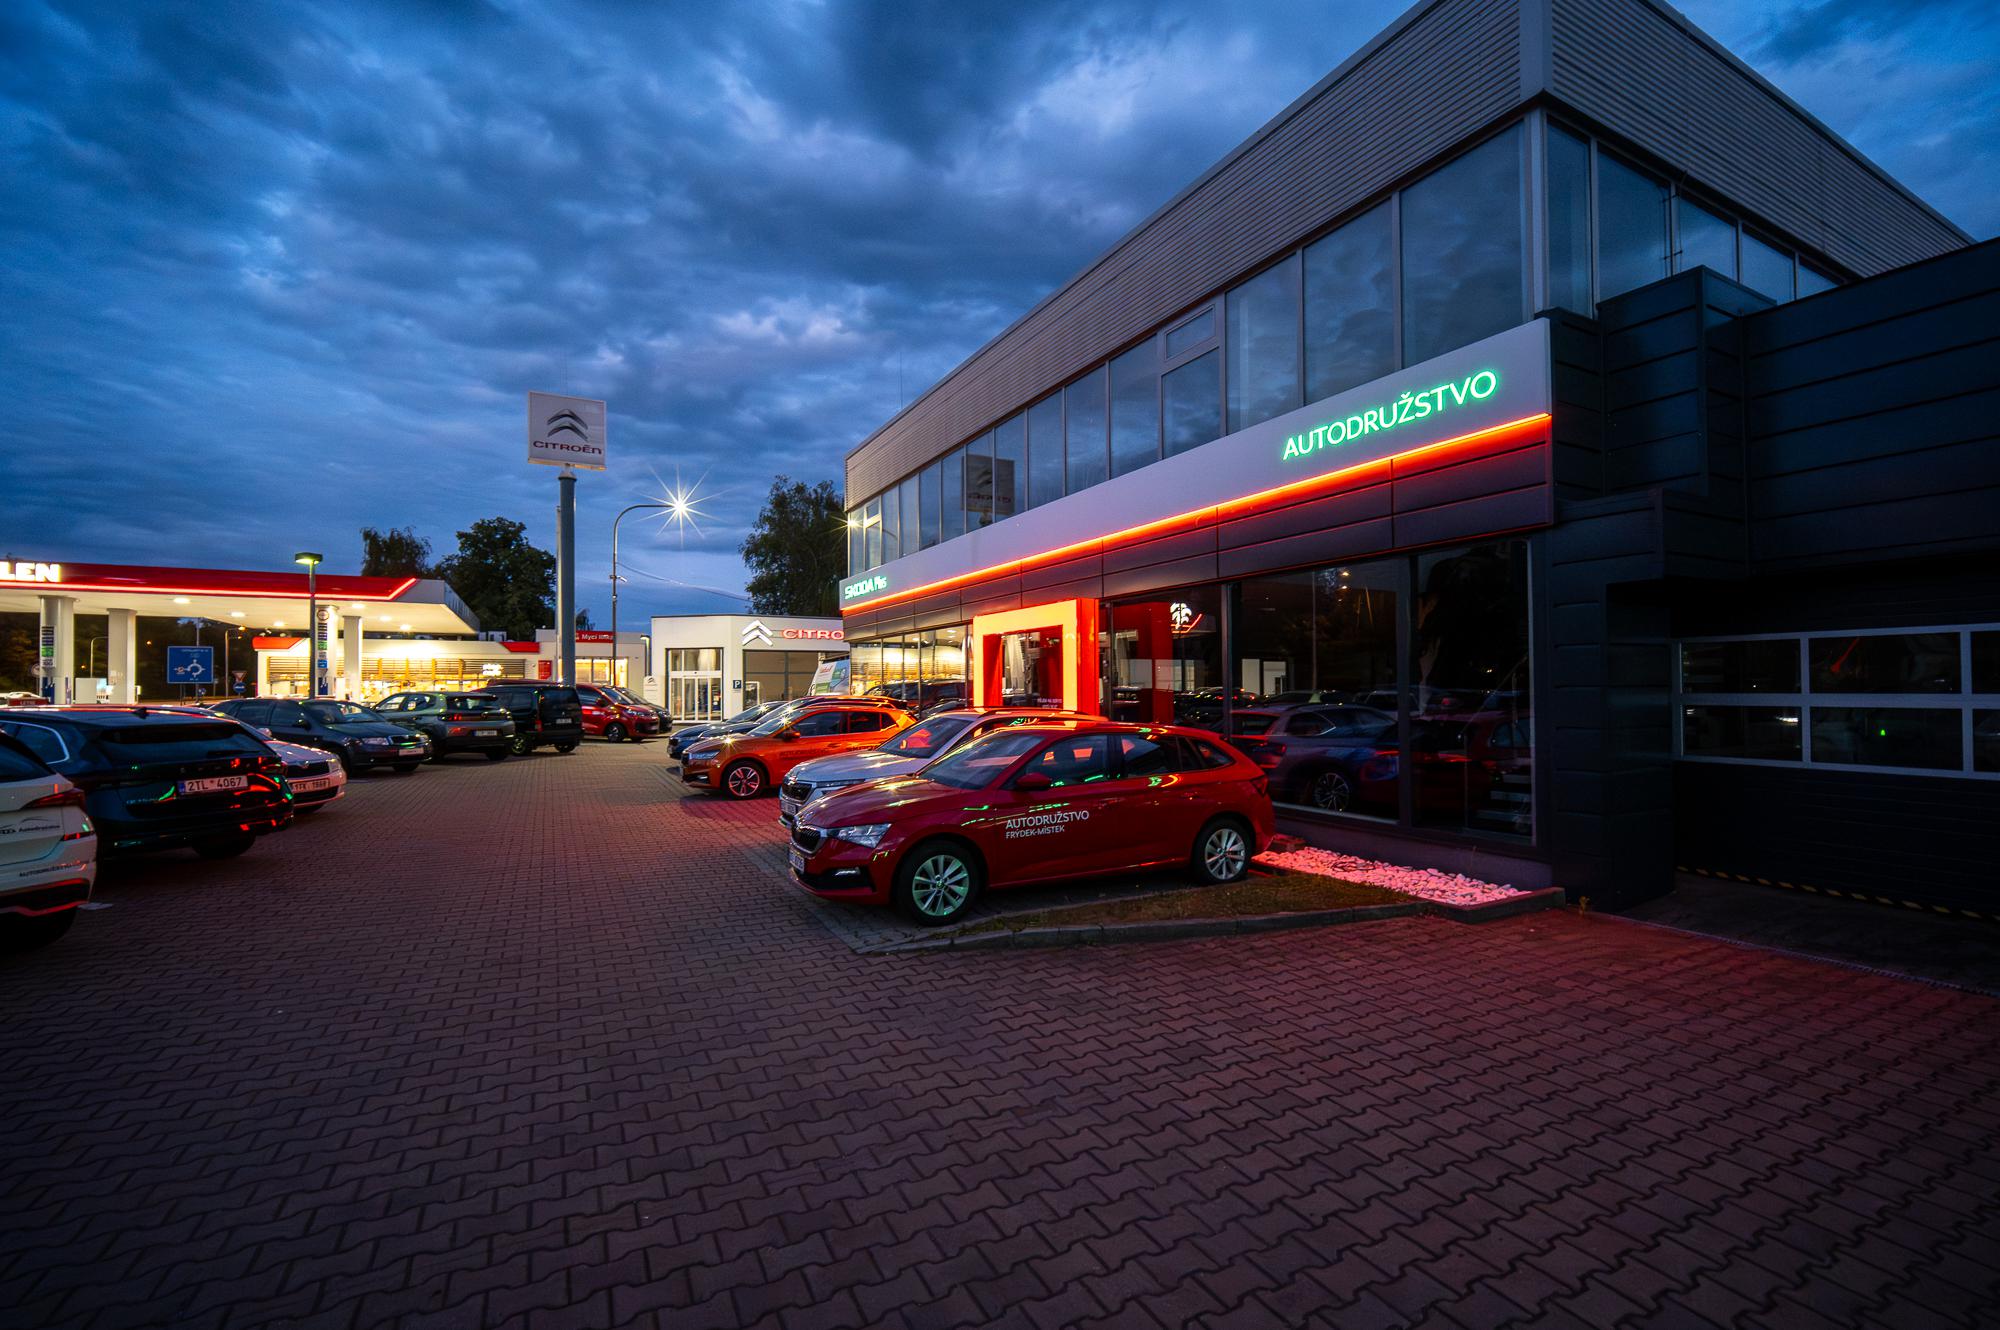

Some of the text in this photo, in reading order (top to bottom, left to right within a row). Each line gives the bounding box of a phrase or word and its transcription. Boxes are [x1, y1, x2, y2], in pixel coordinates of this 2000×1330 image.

[1282, 370, 1497, 461] AUTODRUŽSTVO
[533, 440, 602, 454] CITROËN
[0, 561, 61, 582] LEN
[783, 629, 845, 640] CITRO
[188, 780, 209, 791] 2TL
[1005, 810, 1090, 830] AUTODRUŽSTVO
[1005, 824, 1065, 839] FRÝDEK-MÍSTEK
